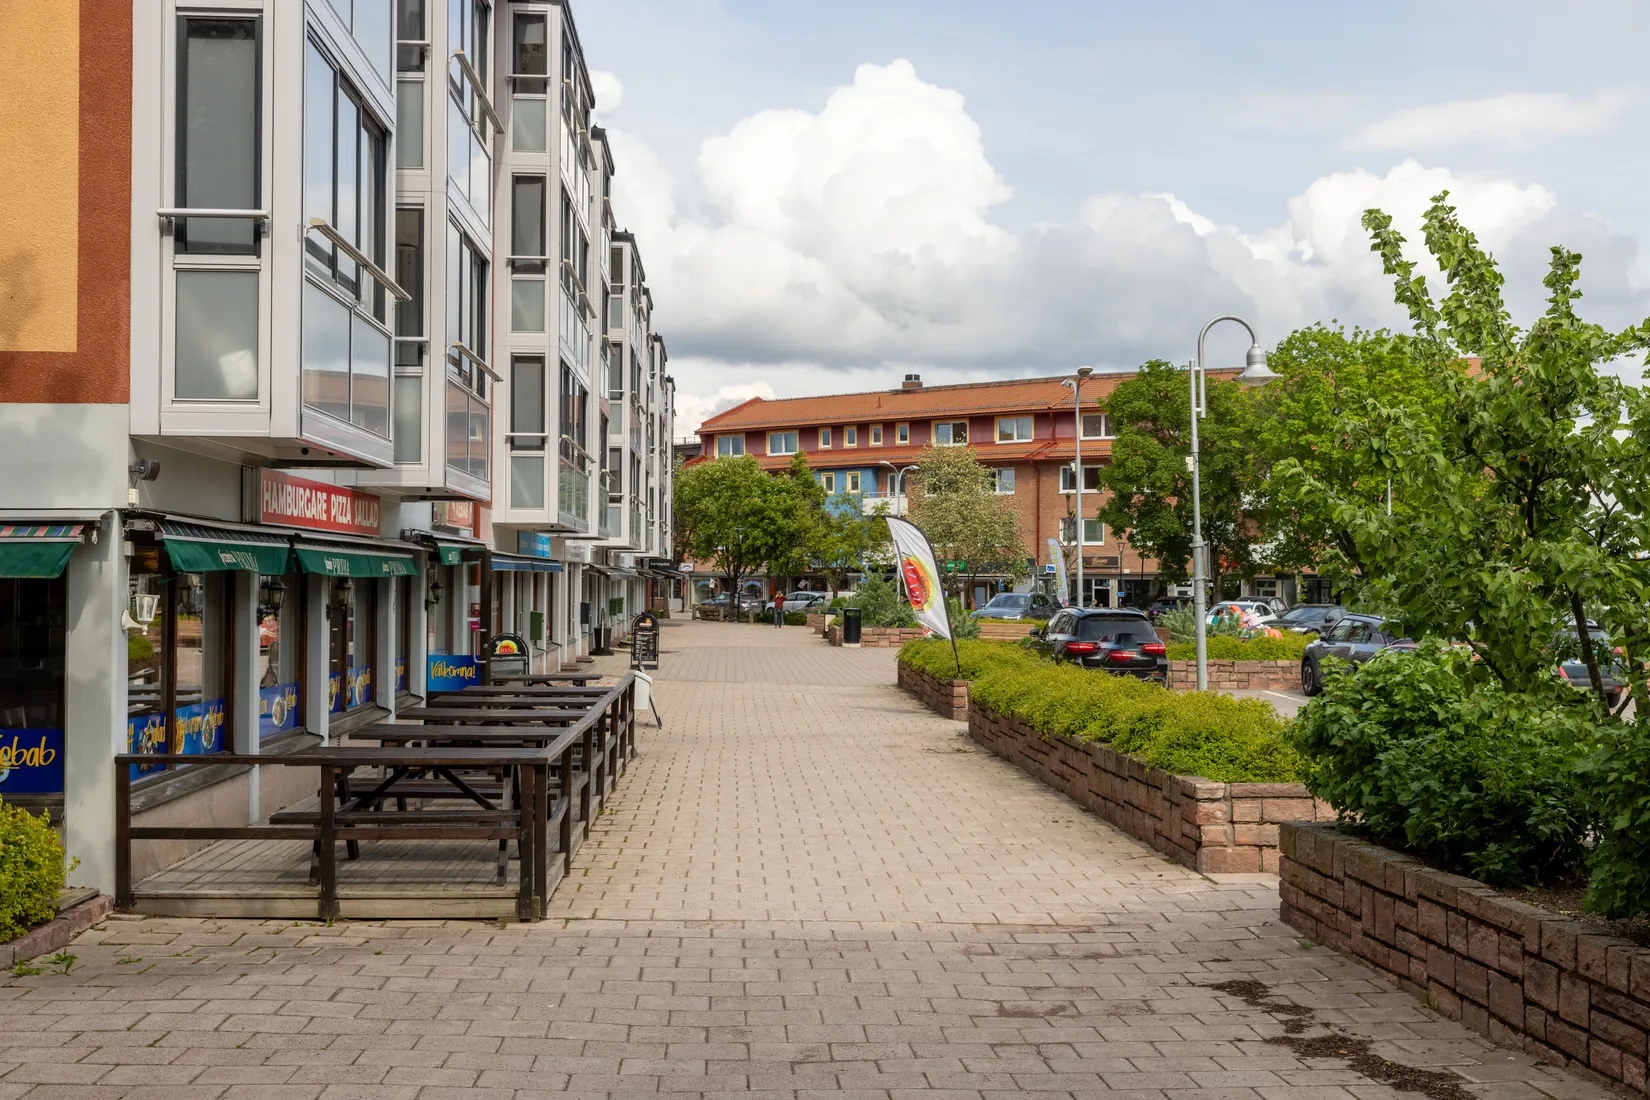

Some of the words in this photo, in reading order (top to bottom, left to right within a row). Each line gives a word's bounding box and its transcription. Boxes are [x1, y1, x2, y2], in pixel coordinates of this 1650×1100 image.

[263, 480, 327, 521] HAMBURGARE
[331, 493, 352, 525] PIZZA
[354, 498, 379, 528] SALLAD
[431, 660, 476, 680] Välkomna!
[0, 734, 56, 769] ebab
